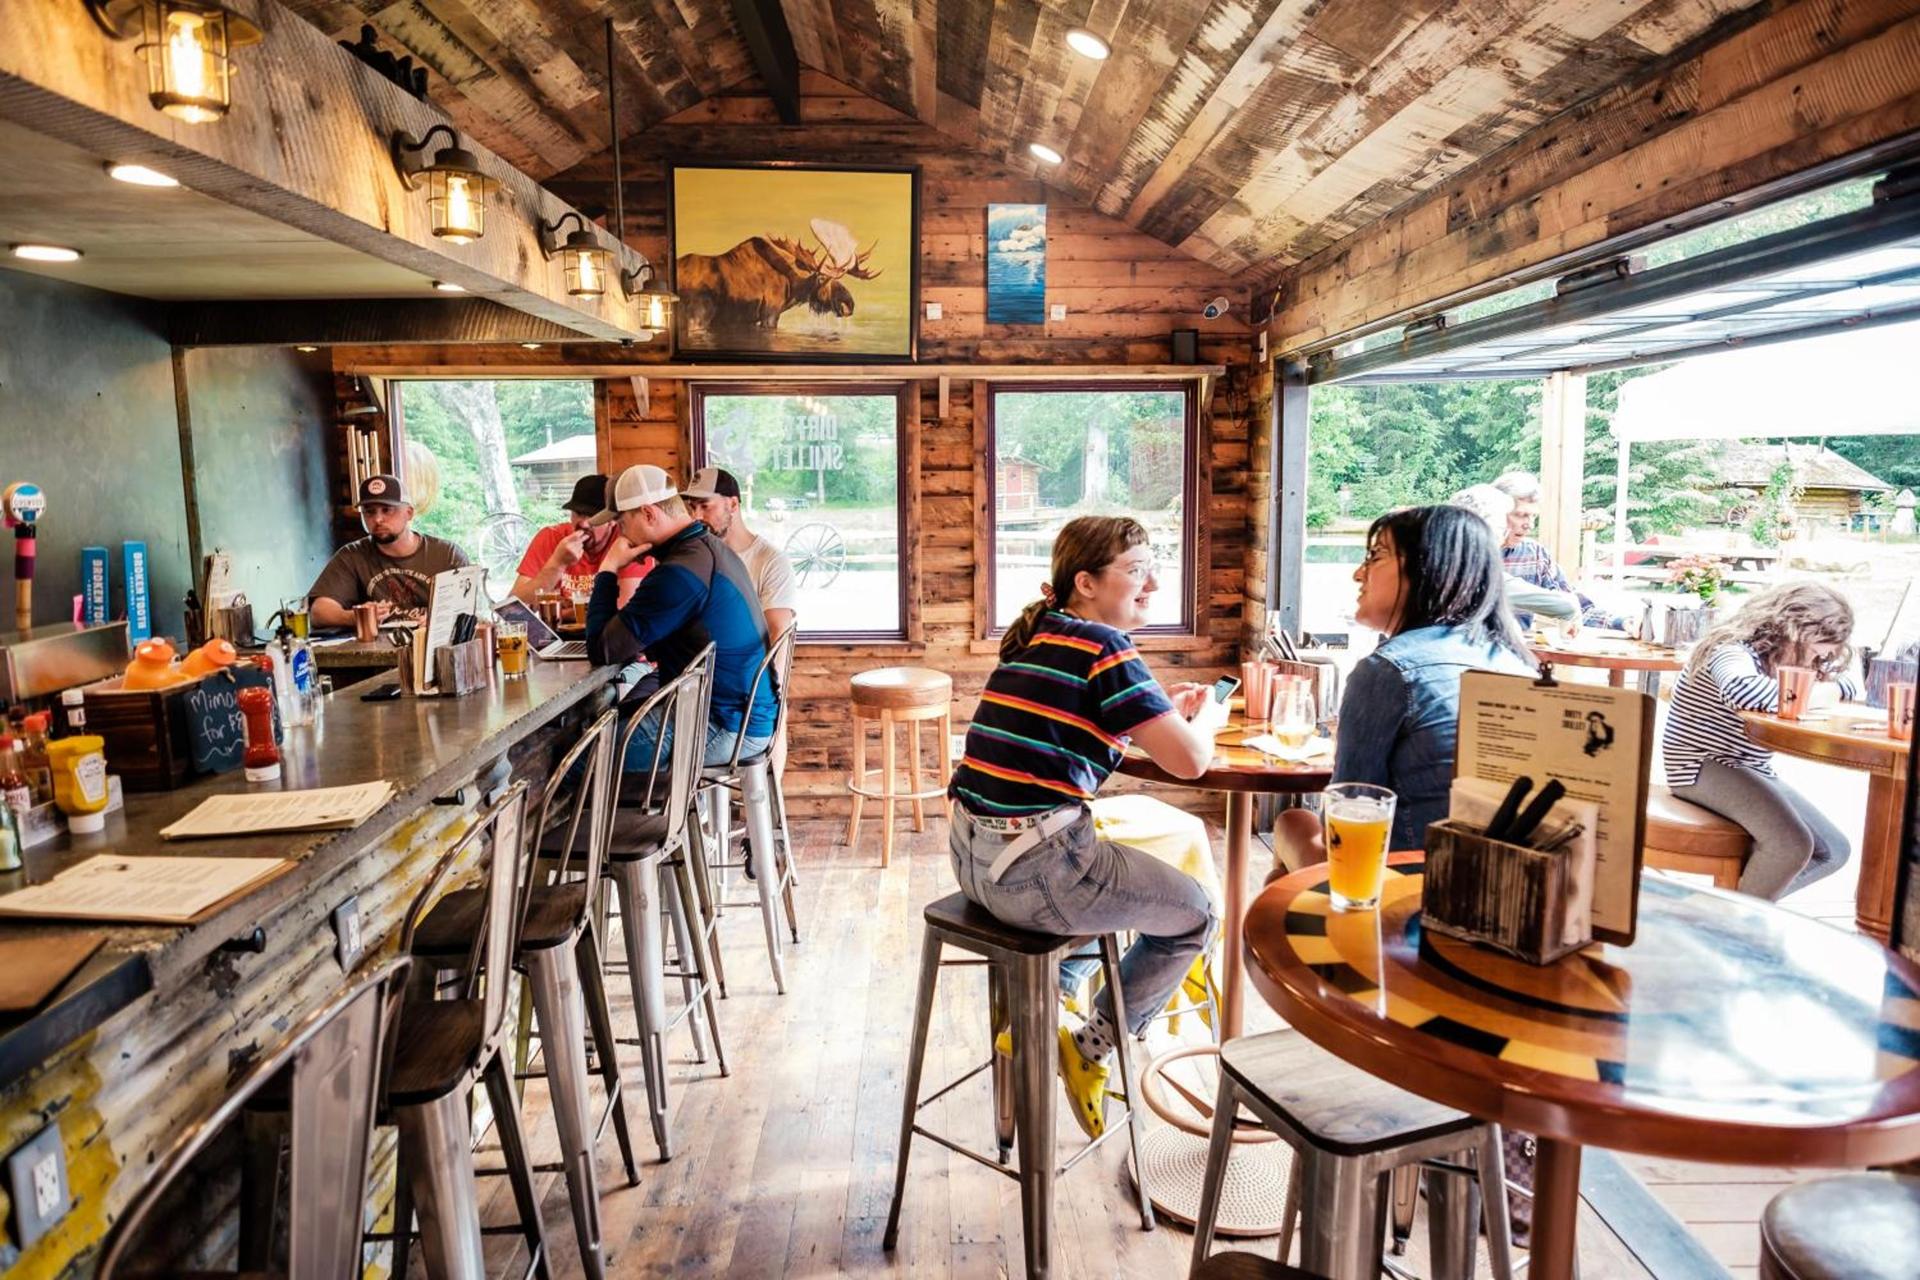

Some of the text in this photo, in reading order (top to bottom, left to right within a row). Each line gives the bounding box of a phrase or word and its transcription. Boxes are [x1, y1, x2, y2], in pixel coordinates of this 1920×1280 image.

[92, 559, 104, 604] BROKEN
[133, 551, 147, 630] BROKEN TOOTH
[190, 690, 235, 713] Mimo
[200, 715, 226, 744] for
